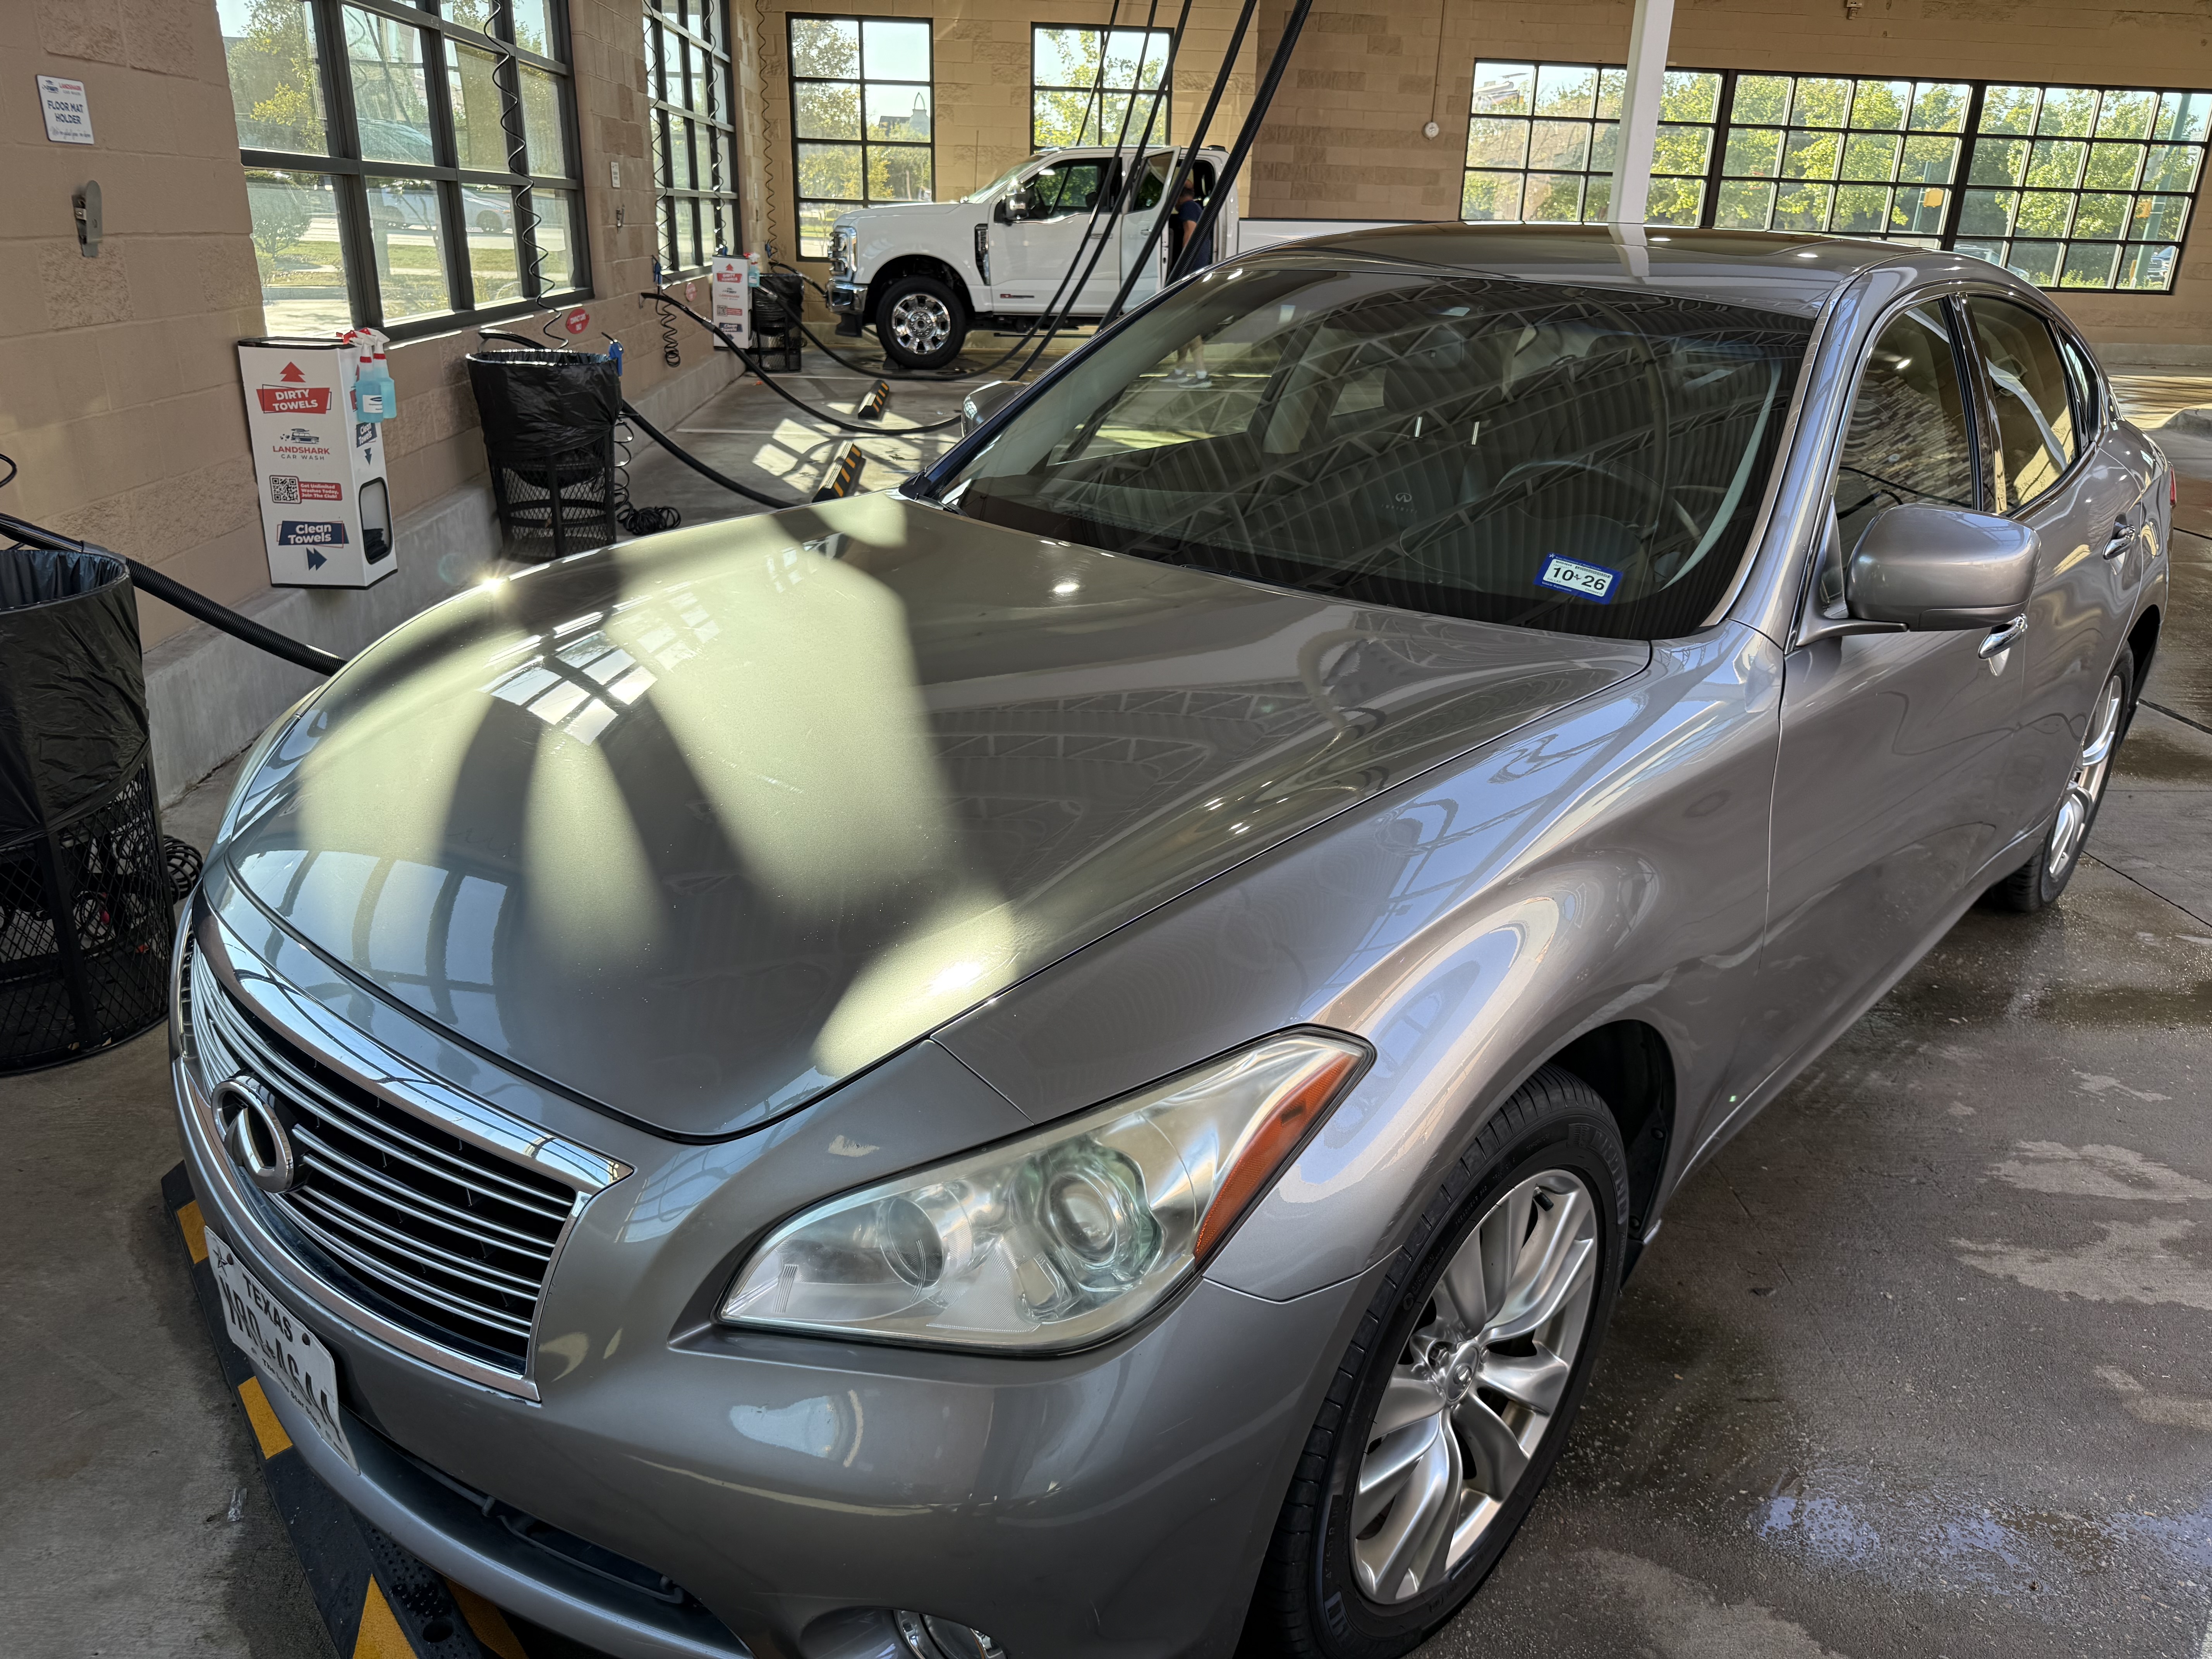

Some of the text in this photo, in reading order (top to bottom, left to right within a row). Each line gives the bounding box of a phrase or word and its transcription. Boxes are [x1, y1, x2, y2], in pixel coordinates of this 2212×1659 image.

[47, 100, 84, 113] FLOOR MAT
[55, 113, 82, 124] HOLDER
[275, 389, 309, 400] DIRTY
[272, 400, 318, 411] TOWELS
[273, 446, 330, 455] LANDSHARK
[295, 524, 331, 534] Clean
[288, 532, 331, 544] Towels
[1554, 567, 1606, 590] 10 26
[242, 1273, 293, 1343] TEXAS
[262, 1358, 275, 1374] The
[290, 1390, 304, 1408] Star
[306, 1406, 321, 1429] State
